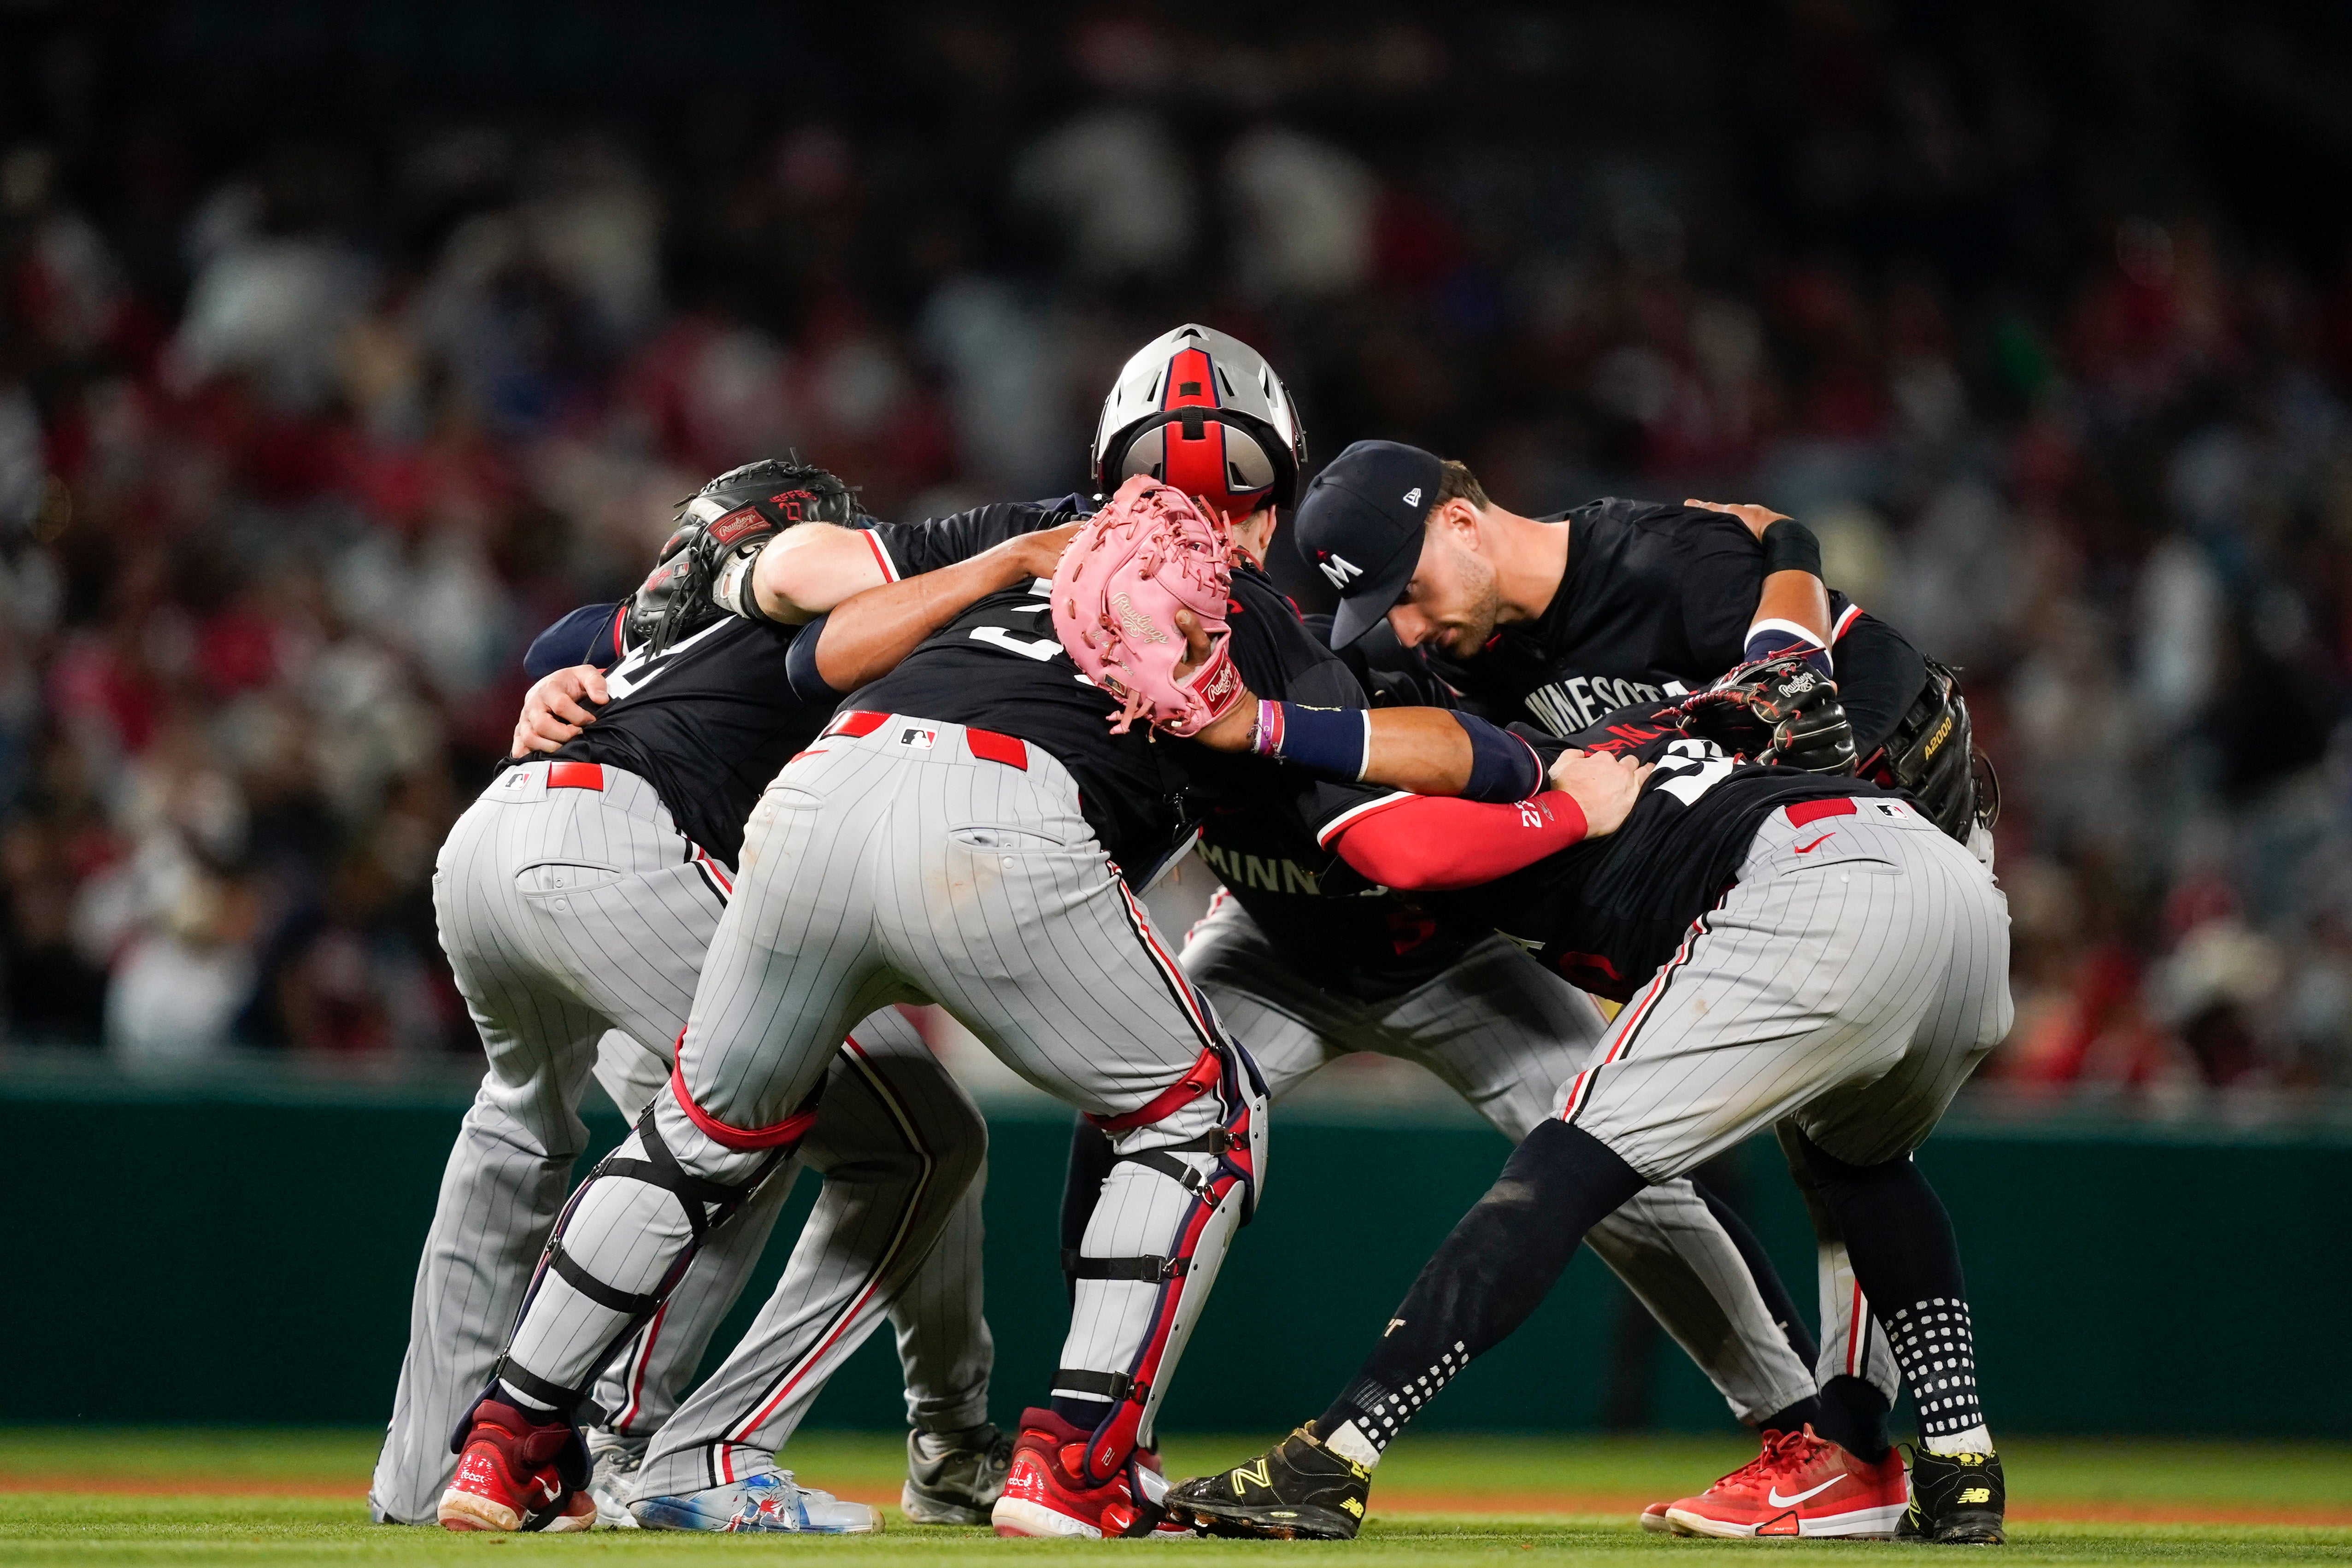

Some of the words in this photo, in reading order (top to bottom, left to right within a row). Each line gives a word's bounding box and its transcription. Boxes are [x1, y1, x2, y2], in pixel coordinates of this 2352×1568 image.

[719, 514, 756, 537] Rawlings
[779, 502, 802, 521] 27
[1319, 554, 1364, 590] M
[1111, 592, 1169, 644] Rawlings
[1208, 661, 1233, 702] Rawlings
[1778, 671, 1816, 698] Rawlings
[1925, 716, 1952, 760] A2000
[1957, 1488, 1990, 1504] NB
